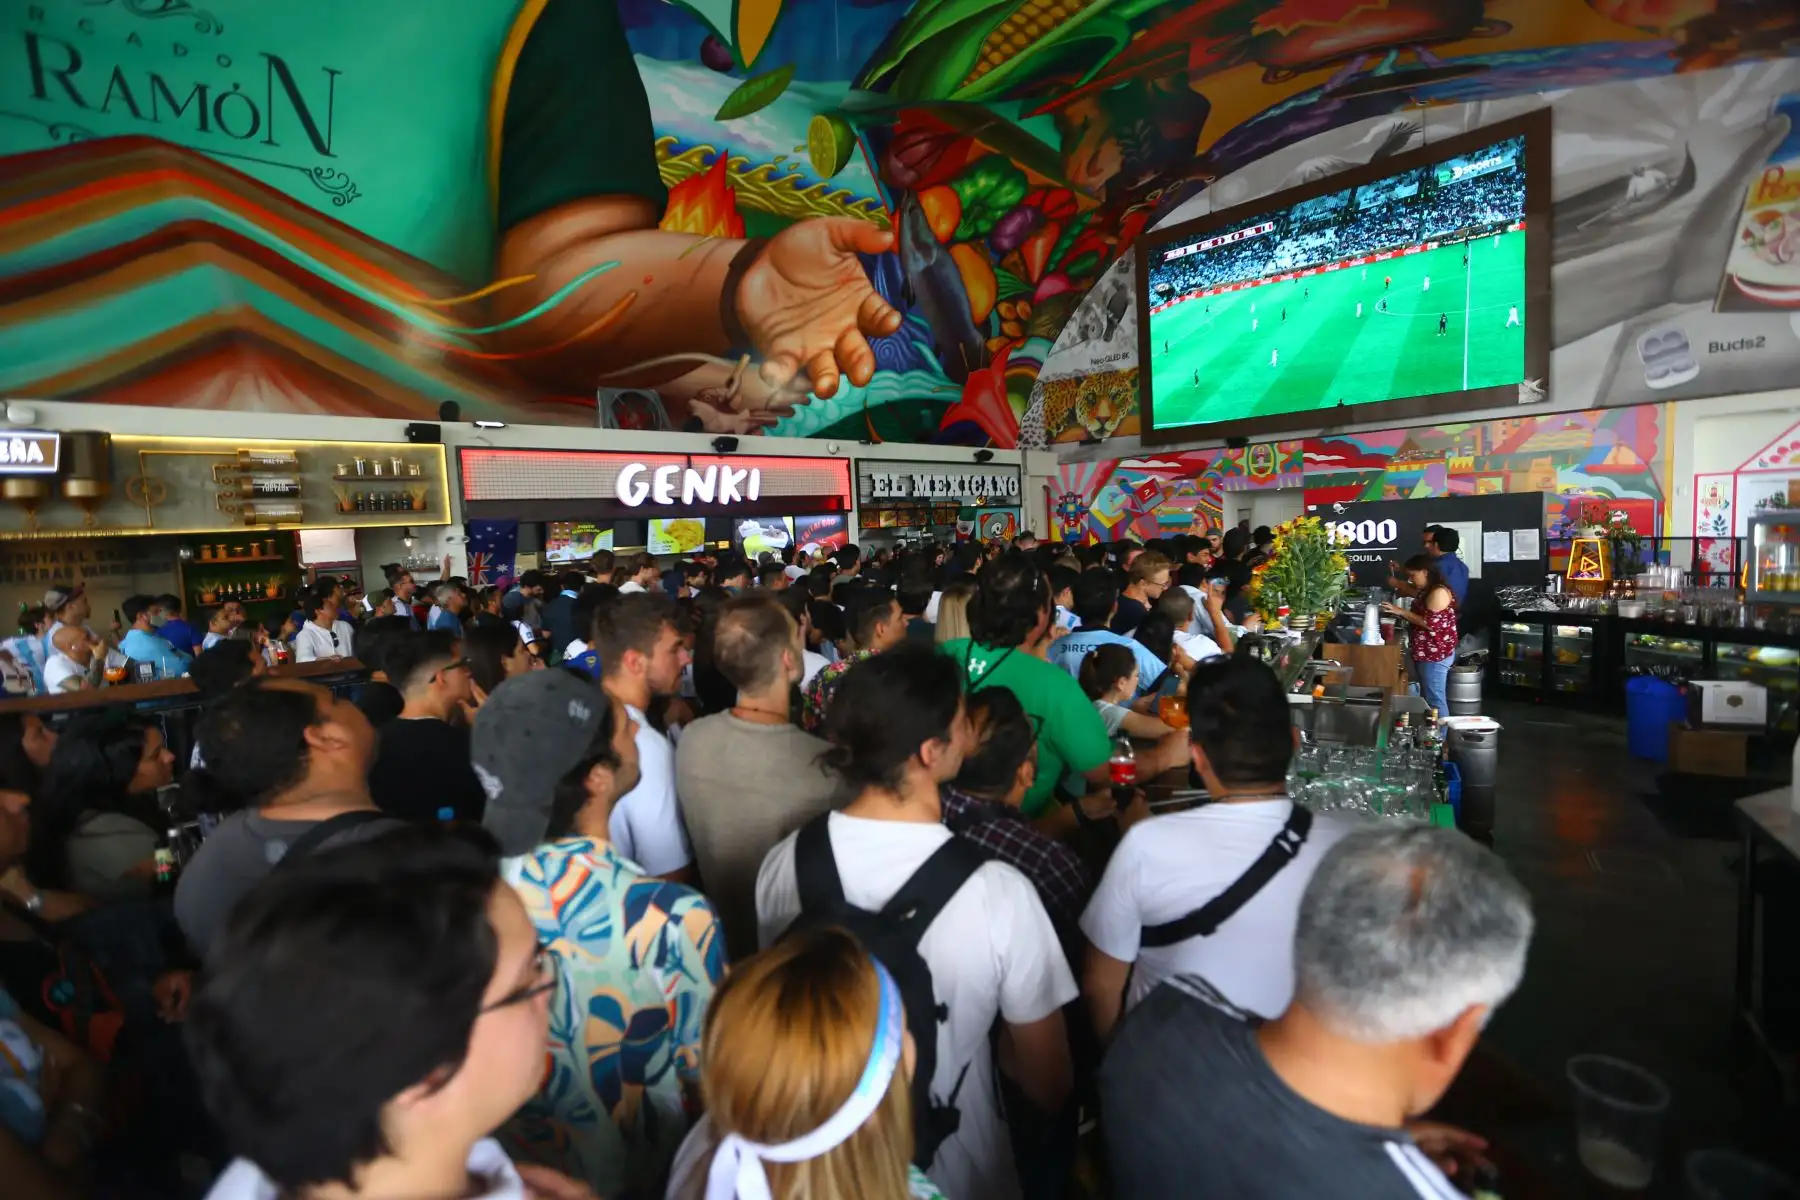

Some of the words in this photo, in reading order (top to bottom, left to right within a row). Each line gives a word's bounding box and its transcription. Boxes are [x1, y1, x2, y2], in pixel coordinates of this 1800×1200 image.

[1708, 336, 1766, 354] Buds2
[615, 462, 761, 508] GENKI
[872, 473, 906, 497] EL
[912, 474, 1019, 497] MEXICANO
[1347, 554, 1383, 562] EQUILA
